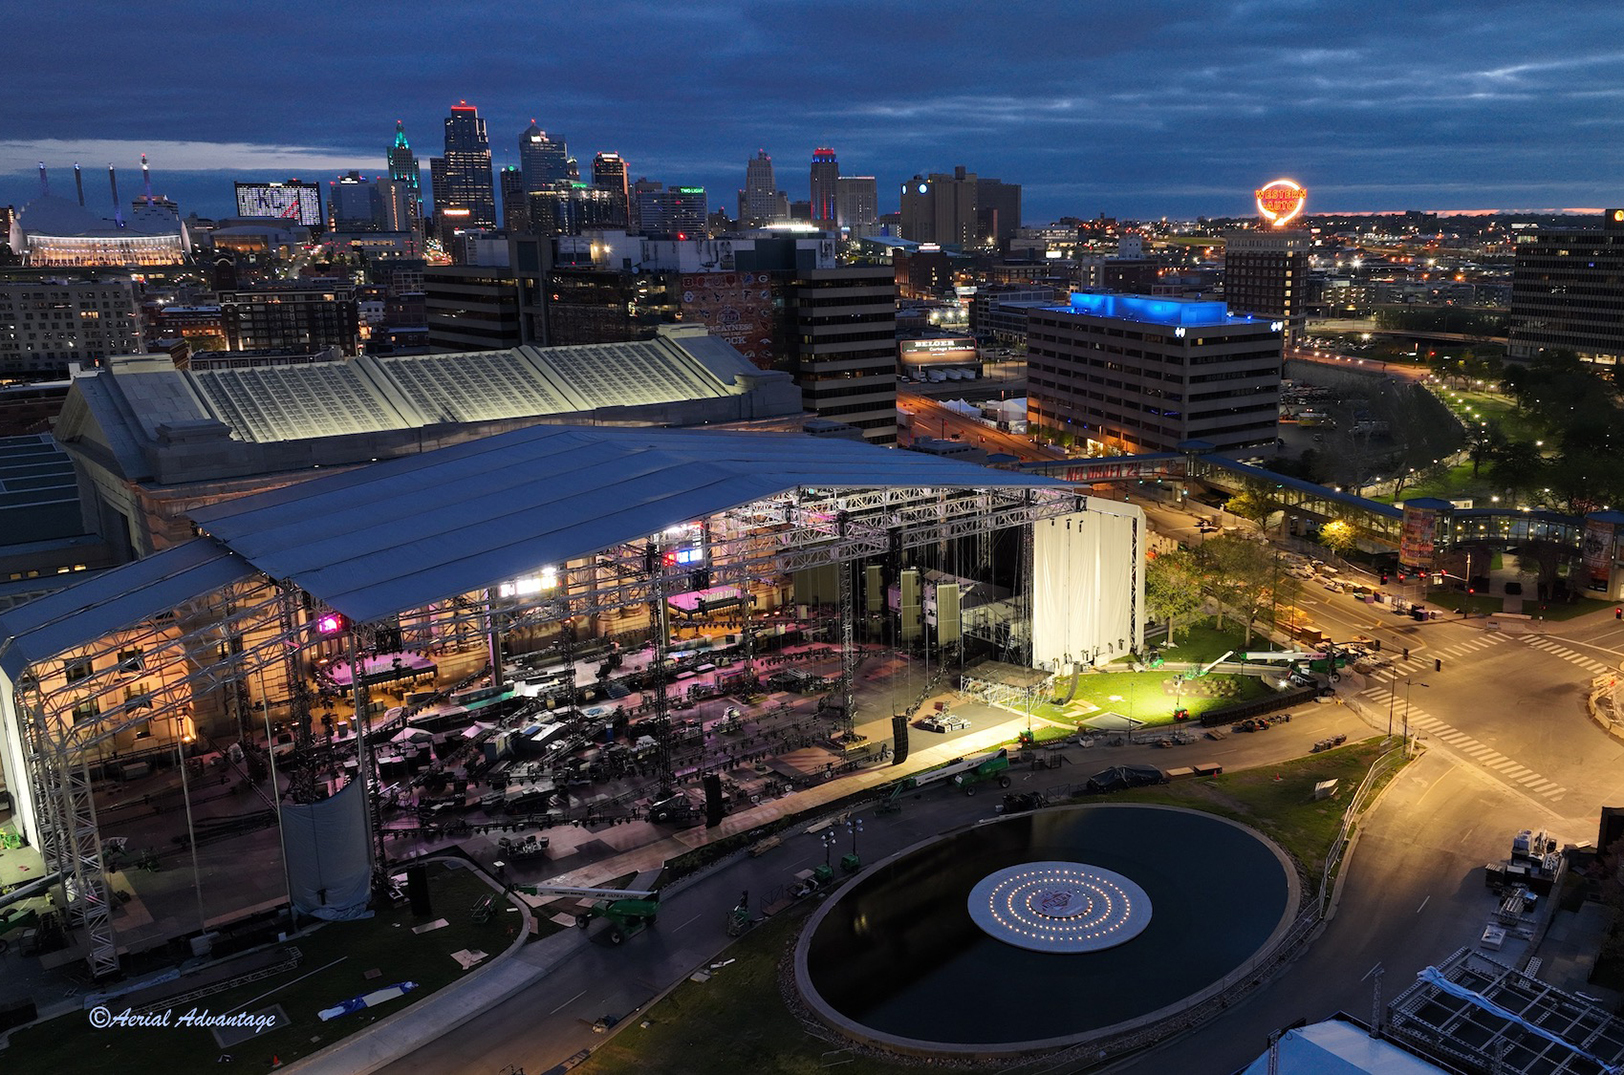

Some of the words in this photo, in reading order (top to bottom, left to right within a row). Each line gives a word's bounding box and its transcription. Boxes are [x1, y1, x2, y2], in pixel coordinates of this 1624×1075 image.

[1255, 189, 1307, 199] WESTERN
[1266, 200, 1296, 211] AUTO
[706, 324, 753, 332] REATNESS
[1066, 465, 1084, 481] NFL
[1087, 462, 1121, 479] DRAFT
